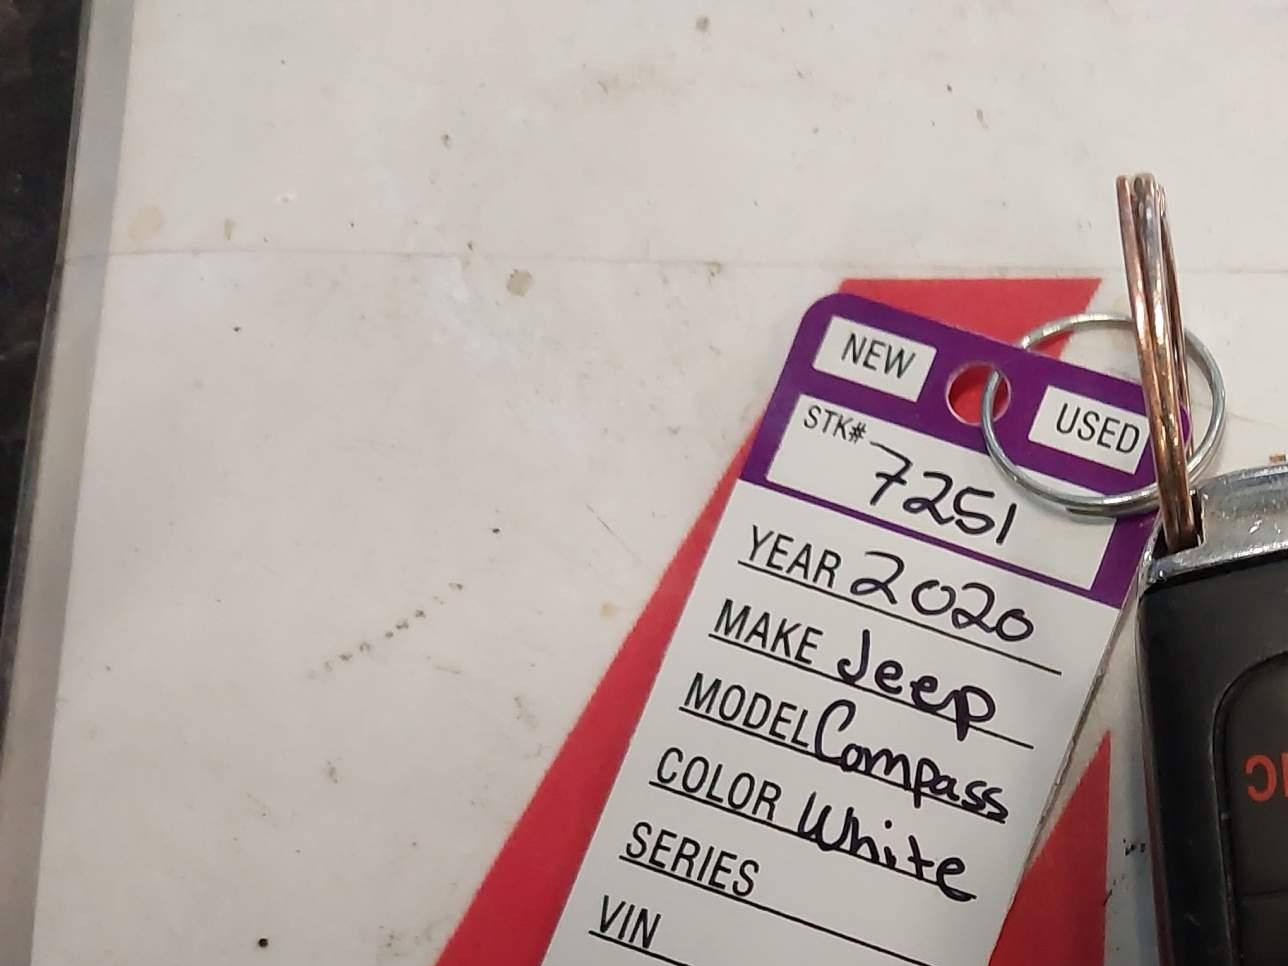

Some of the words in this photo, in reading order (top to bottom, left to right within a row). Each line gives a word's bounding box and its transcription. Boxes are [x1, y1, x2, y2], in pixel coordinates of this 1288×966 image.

[840, 332, 916, 379] NEW
[803, 405, 867, 442] STK#
[868, 440, 1017, 544] 7251
[1055, 402, 1140, 454] USED
[748, 525, 842, 588] YEAR
[849, 550, 1034, 642] 2020
[713, 598, 823, 665] MAKE
[837, 629, 996, 741] Jeep
[683, 672, 809, 748] MODEL
[814, 699, 1009, 821] Compass
[625, 821, 760, 896] SERIES
[656, 747, 782, 821] COLOR
[799, 792, 977, 902] White
[599, 895, 661, 949] VIN
